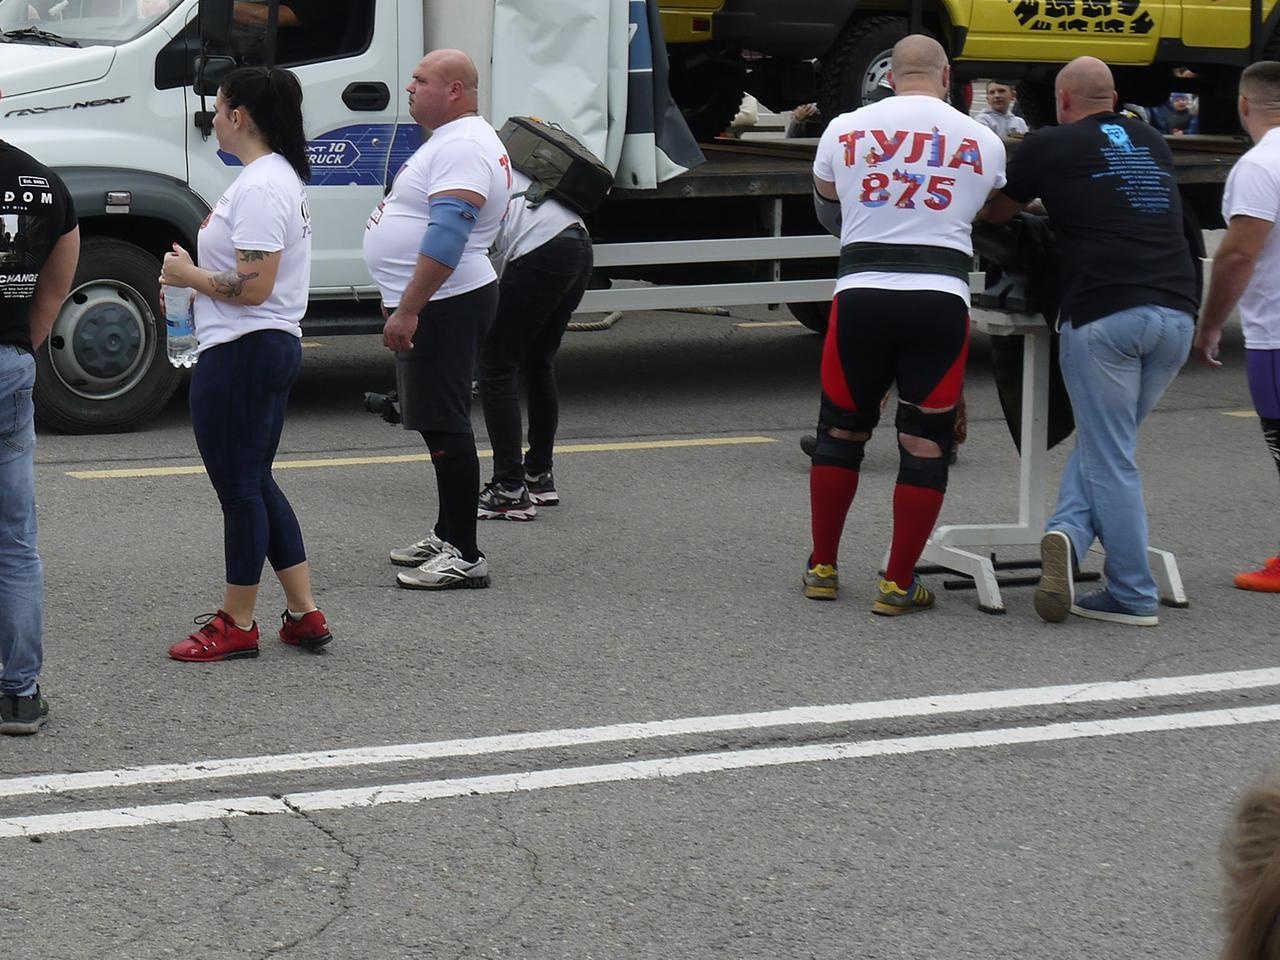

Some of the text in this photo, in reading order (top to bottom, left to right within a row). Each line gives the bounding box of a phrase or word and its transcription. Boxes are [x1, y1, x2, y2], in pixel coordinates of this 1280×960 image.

[307, 154, 345, 164] RUCK
[329, 143, 347, 153] 10
[838, 125, 983, 176] ТУЛА
[859, 168, 957, 211] 875
